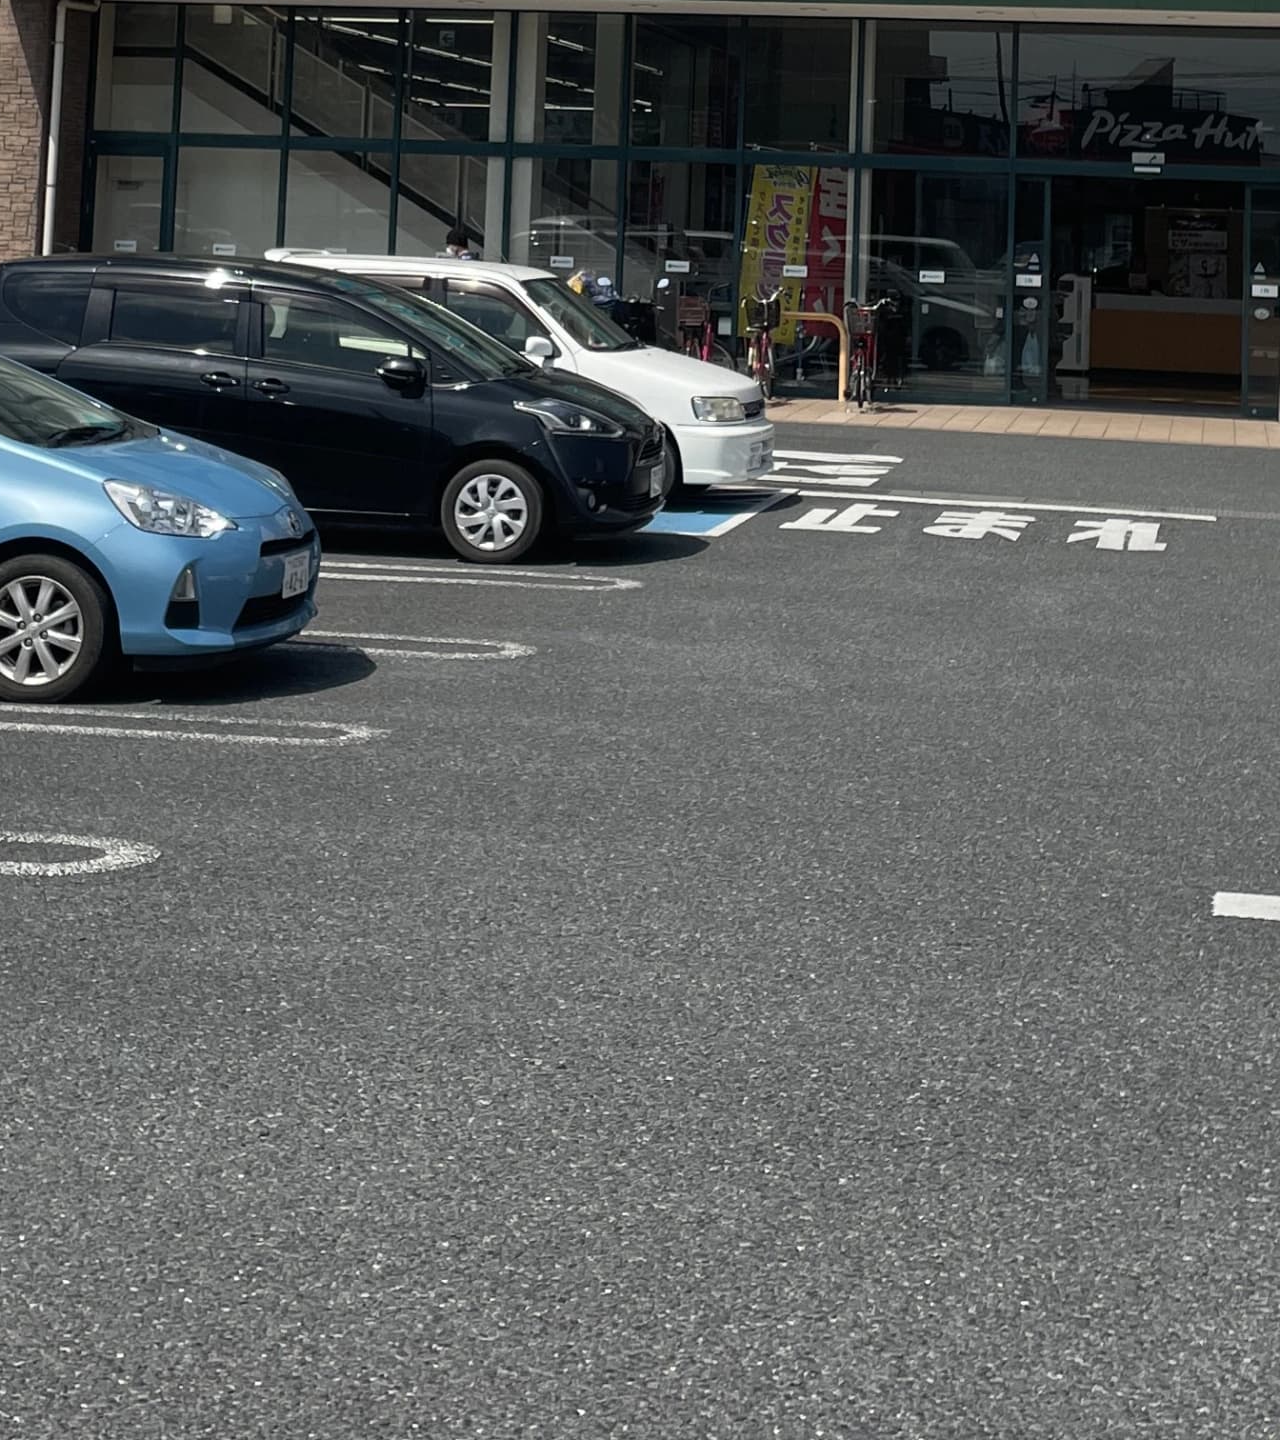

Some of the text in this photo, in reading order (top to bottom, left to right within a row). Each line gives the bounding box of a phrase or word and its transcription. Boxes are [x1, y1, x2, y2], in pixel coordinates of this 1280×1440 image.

[1081, 109, 1266, 151] Pizza Hut
[779, 503, 1168, 552] 止まれ
